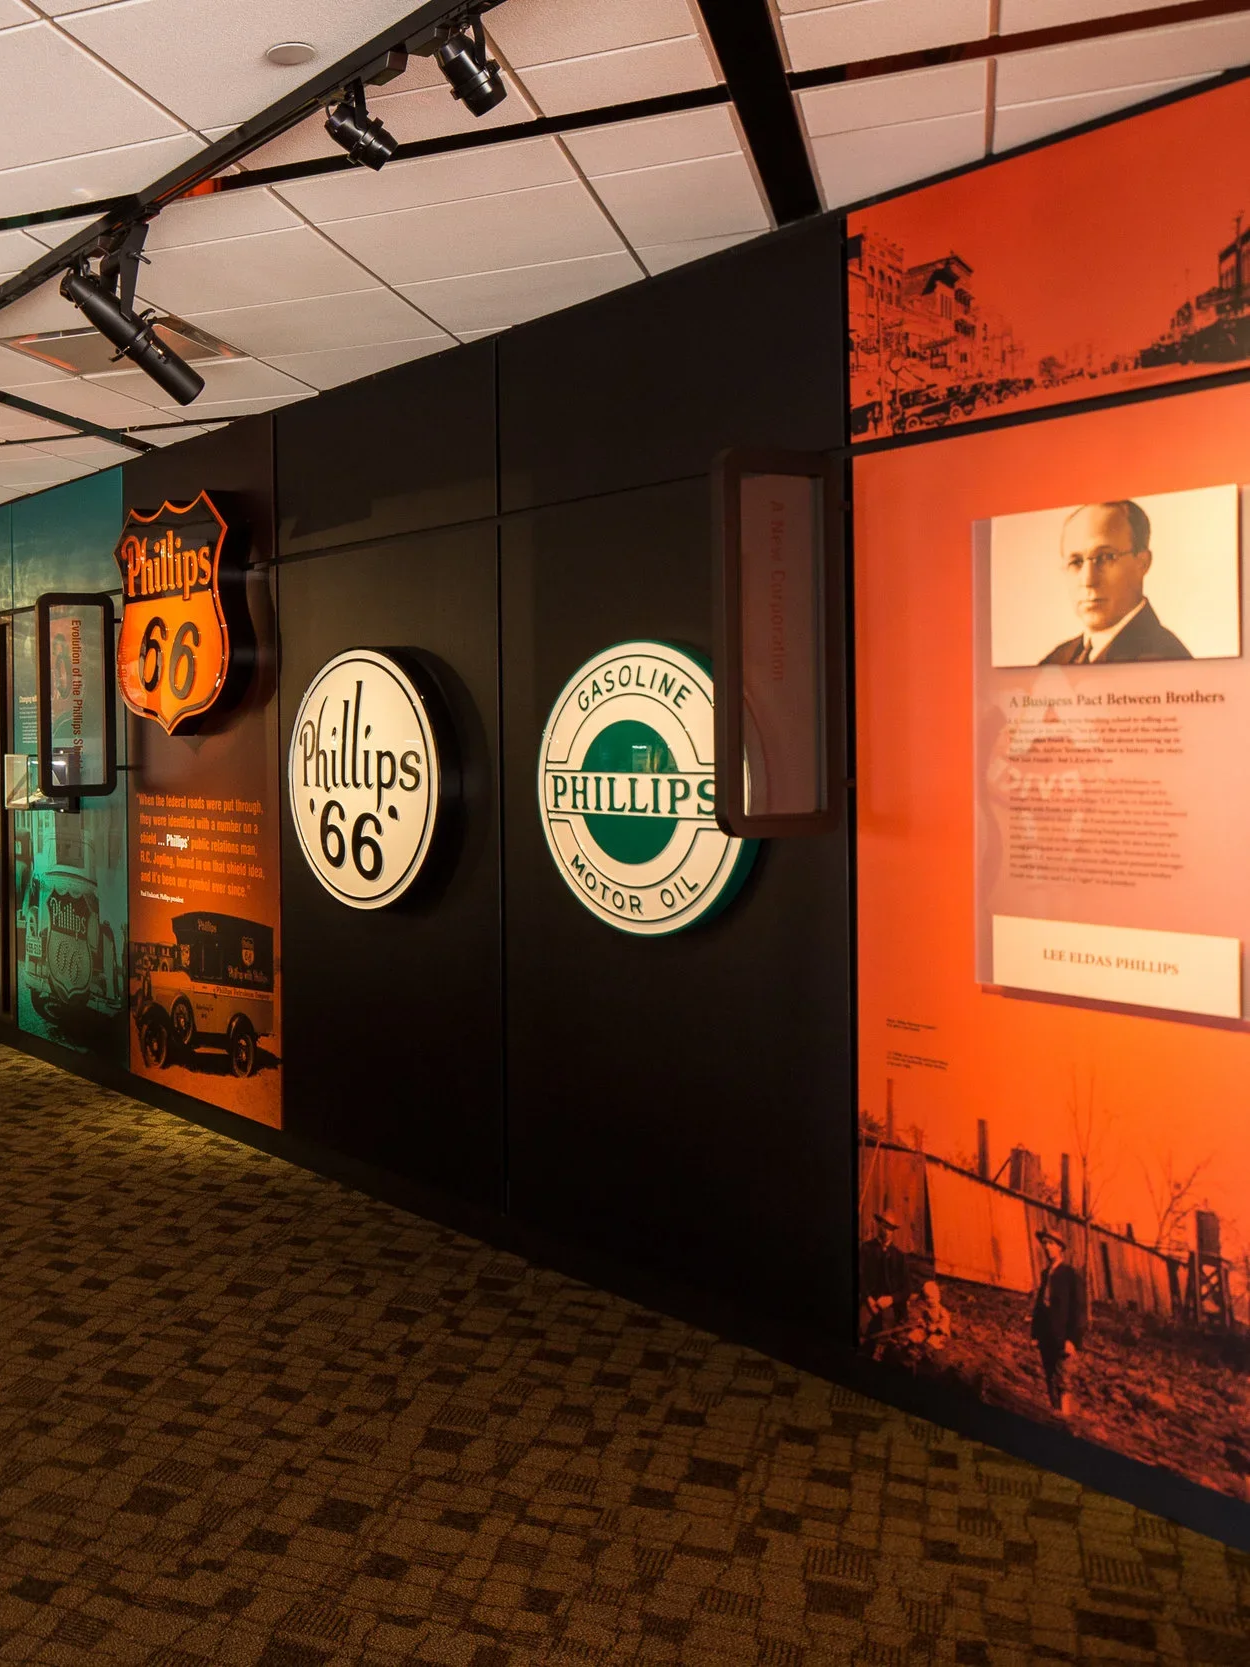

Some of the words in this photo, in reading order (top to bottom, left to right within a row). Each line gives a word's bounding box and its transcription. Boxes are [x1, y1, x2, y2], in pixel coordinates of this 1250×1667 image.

[121, 529, 211, 601] Phillips
[71, 619, 82, 665] Evolution
[139, 616, 200, 700] 66
[71, 667, 82, 678] of
[71, 678, 82, 696] the
[578, 663, 693, 713] GASOLINE
[1009, 695, 1018, 708] A
[1022, 694, 1073, 707] Business
[1077, 694, 1102, 706] Pact
[1107, 692, 1162, 705] Between
[1166, 689, 1226, 703] Brothers
[71, 699, 84, 736] Phillips
[300, 680, 422, 813] Phillips
[156, 795, 165, 807] the
[166, 795, 186, 808] federal
[188, 796, 205, 809] roads
[206, 799, 222, 811] were
[224, 799, 234, 814] put
[236, 799, 263, 816] through,
[140, 813, 151, 828] they
[153, 816, 167, 827] were
[168, 814, 195, 829] identified
[196, 817, 210, 830] with
[217, 819, 241, 833] number
[243, 823, 252, 834] on
[253, 823, 259, 835] a
[140, 832, 157, 845] shield
[166, 833, 190, 851] Phillips'
[191, 837, 210, 852] public
[211, 839, 239, 855] relations
[141, 870, 151, 883] and
[162, 872, 176, 886] been
[177, 877, 188, 888] our
[189, 878, 211, 893] symbol
[212, 882, 225, 894] ever
[196, 857, 202, 870] in
[213, 860, 225, 873] that
[227, 861, 247, 876] shield
[570, 853, 644, 916] MOTOR
[660, 875, 699, 910] OIL
[50, 896, 86, 941] Phillips
[55, 940, 84, 985] 66
[1043, 948, 1066, 962] LEE
[1069, 951, 1113, 968] ELDAS
[1116, 956, 1180, 976] PHILLIPS
